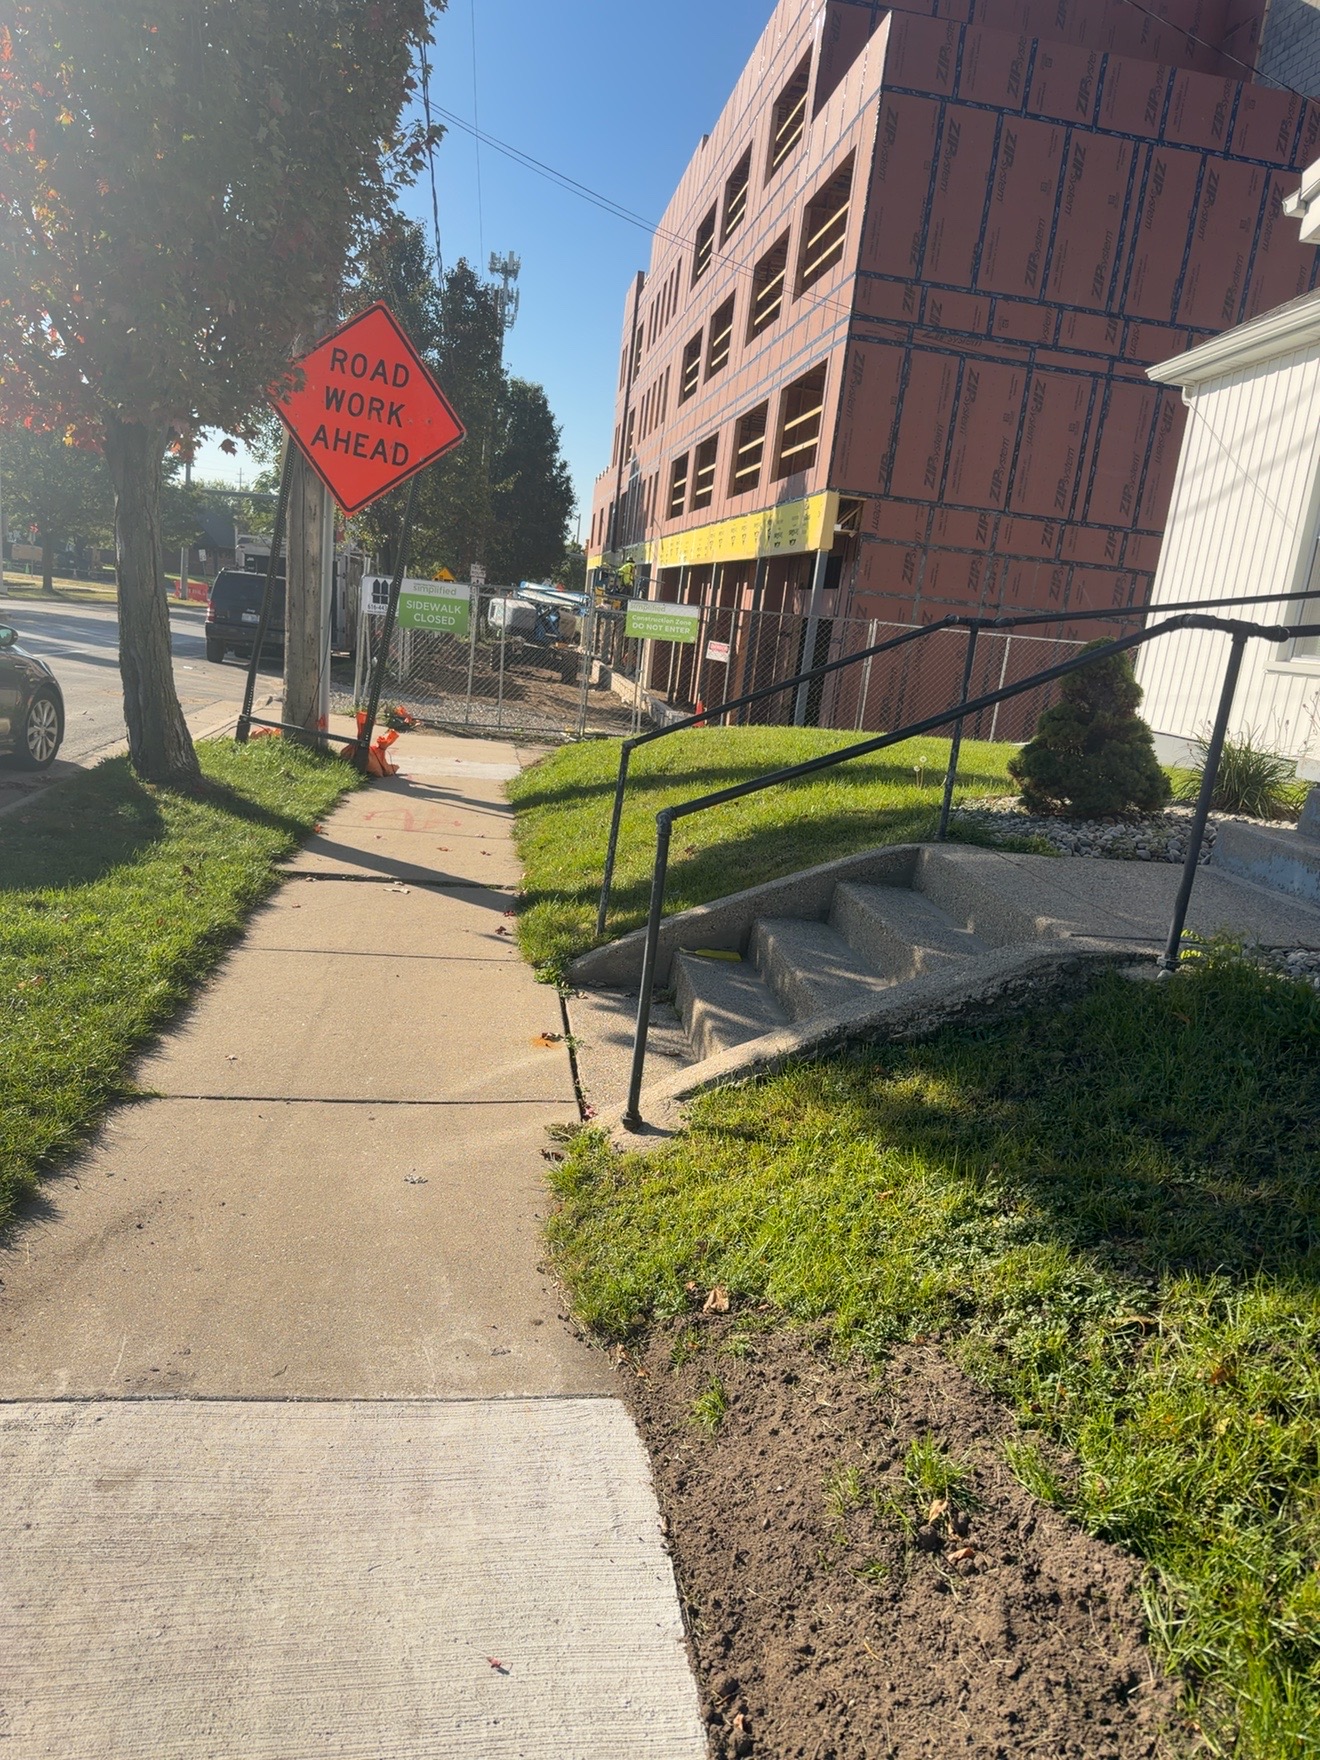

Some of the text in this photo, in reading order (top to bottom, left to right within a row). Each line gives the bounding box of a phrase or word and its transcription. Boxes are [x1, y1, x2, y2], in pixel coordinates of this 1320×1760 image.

[330, 347, 410, 388] ROAD
[324, 386, 405, 428] WORK
[310, 424, 409, 467] AHEAD
[413, 585, 457, 596] simplified
[406, 600, 462, 614] SIDEWALK
[414, 613, 455, 625] CLOSED
[632, 615, 674, 624] Construction
[665, 625, 690, 634] ENTER
